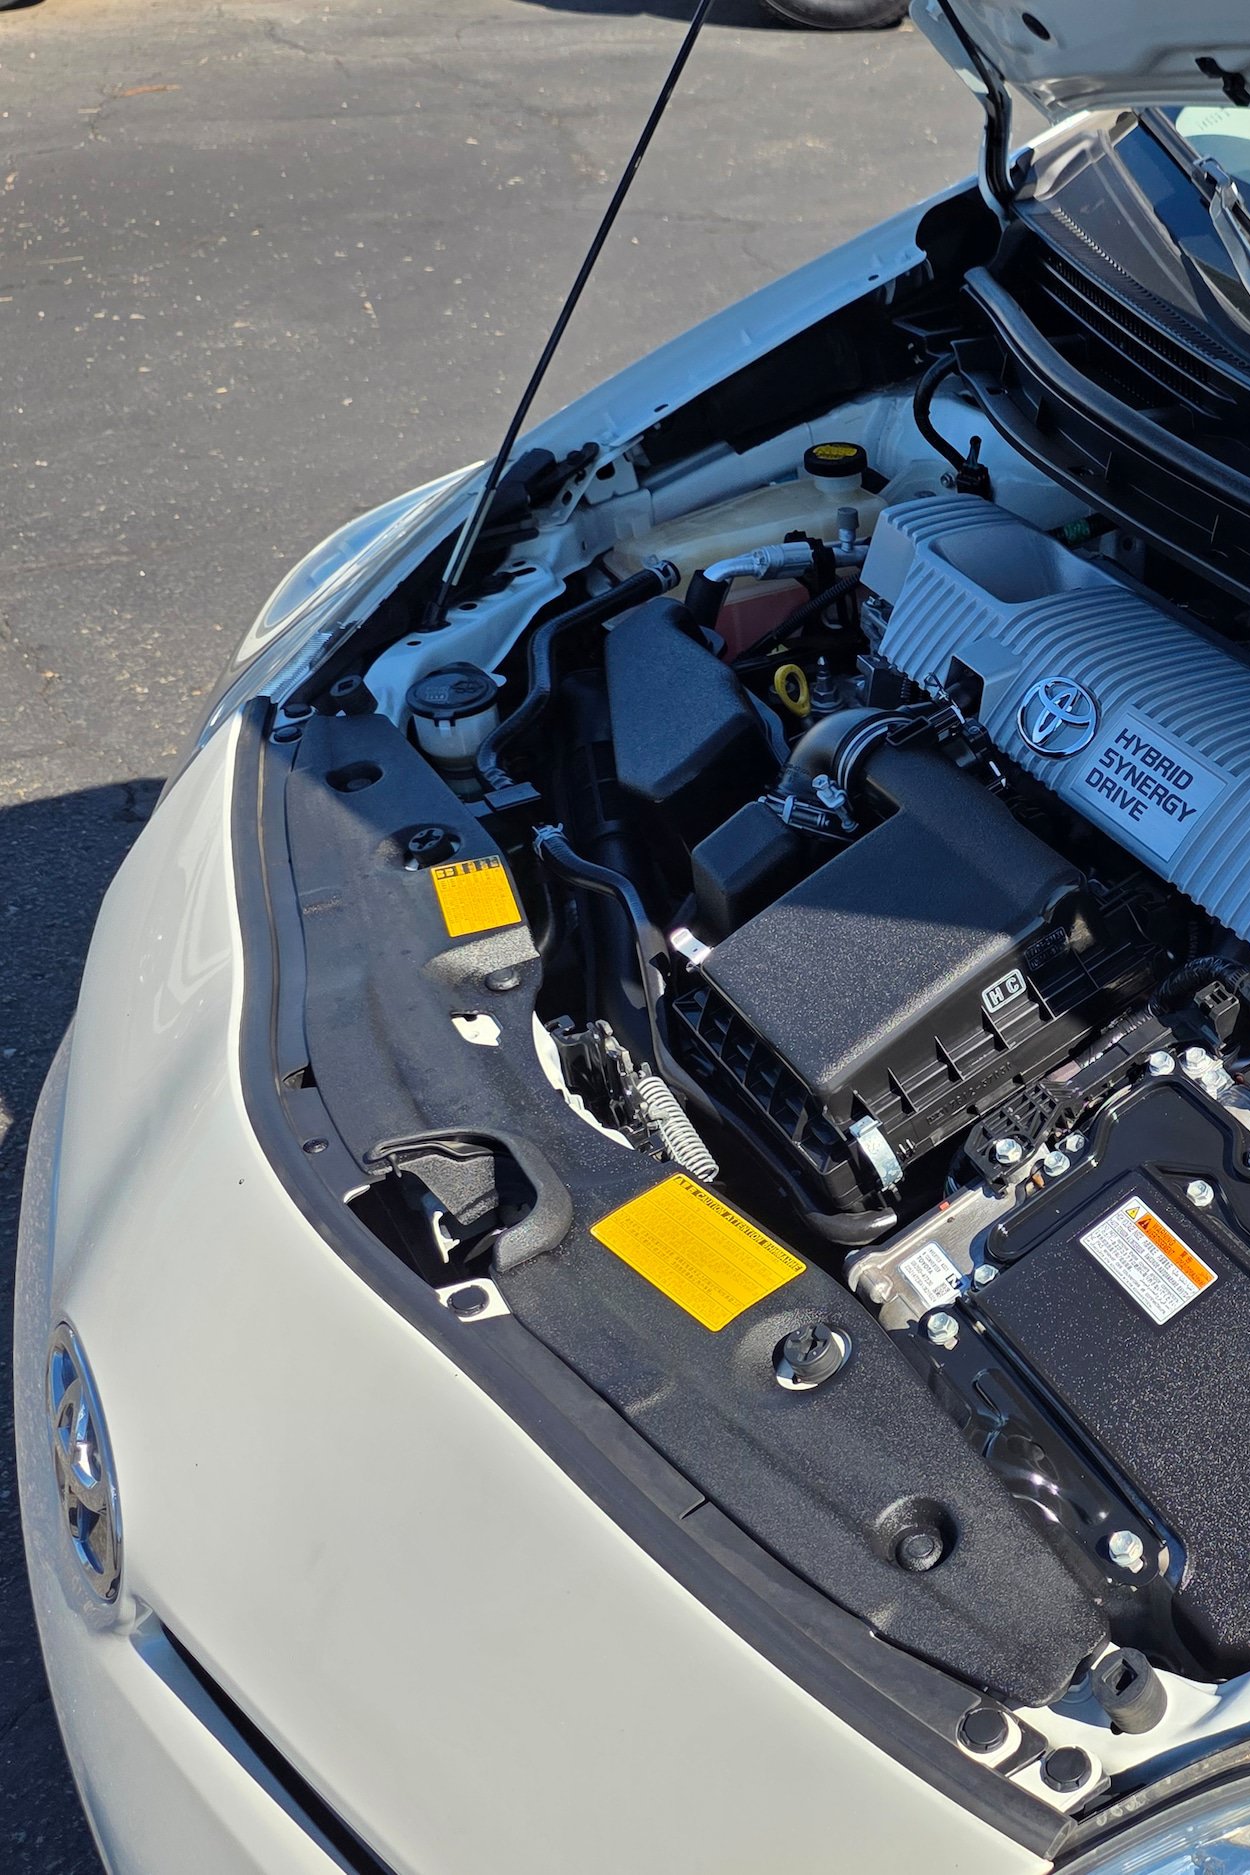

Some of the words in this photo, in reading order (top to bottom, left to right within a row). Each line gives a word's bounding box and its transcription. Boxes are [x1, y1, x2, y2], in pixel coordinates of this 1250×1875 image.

[1099, 748, 1197, 822] SYNERGY
[1114, 728, 1194, 790] HYBRID
[1085, 767, 1149, 822] DRIVE
[696, 1191, 726, 1215] CAUTION
[725, 1212, 763, 1244] ATTENTION
[917, 1255, 933, 1274] TOYOTA
